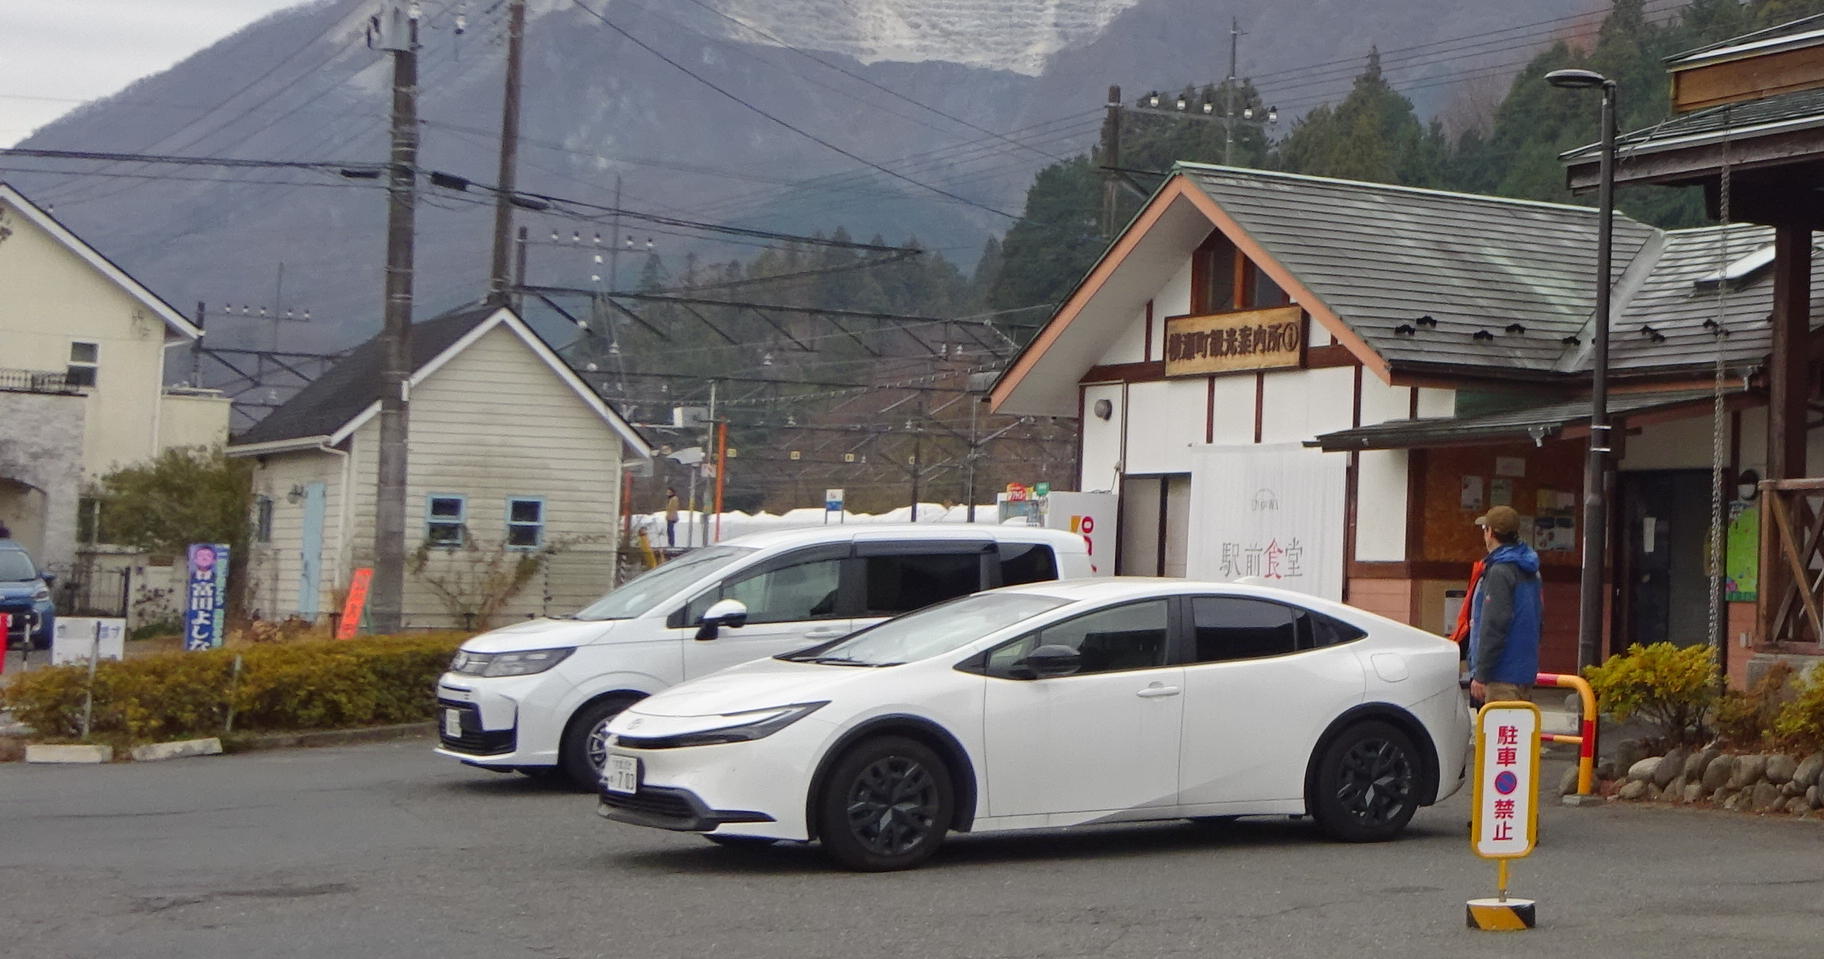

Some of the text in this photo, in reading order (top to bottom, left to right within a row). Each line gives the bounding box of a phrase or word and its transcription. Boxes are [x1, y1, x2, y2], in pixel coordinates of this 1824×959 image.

[1219, 537, 1303, 579] 駅前食堂
[1492, 726, 1519, 841] 駐車 禁止
